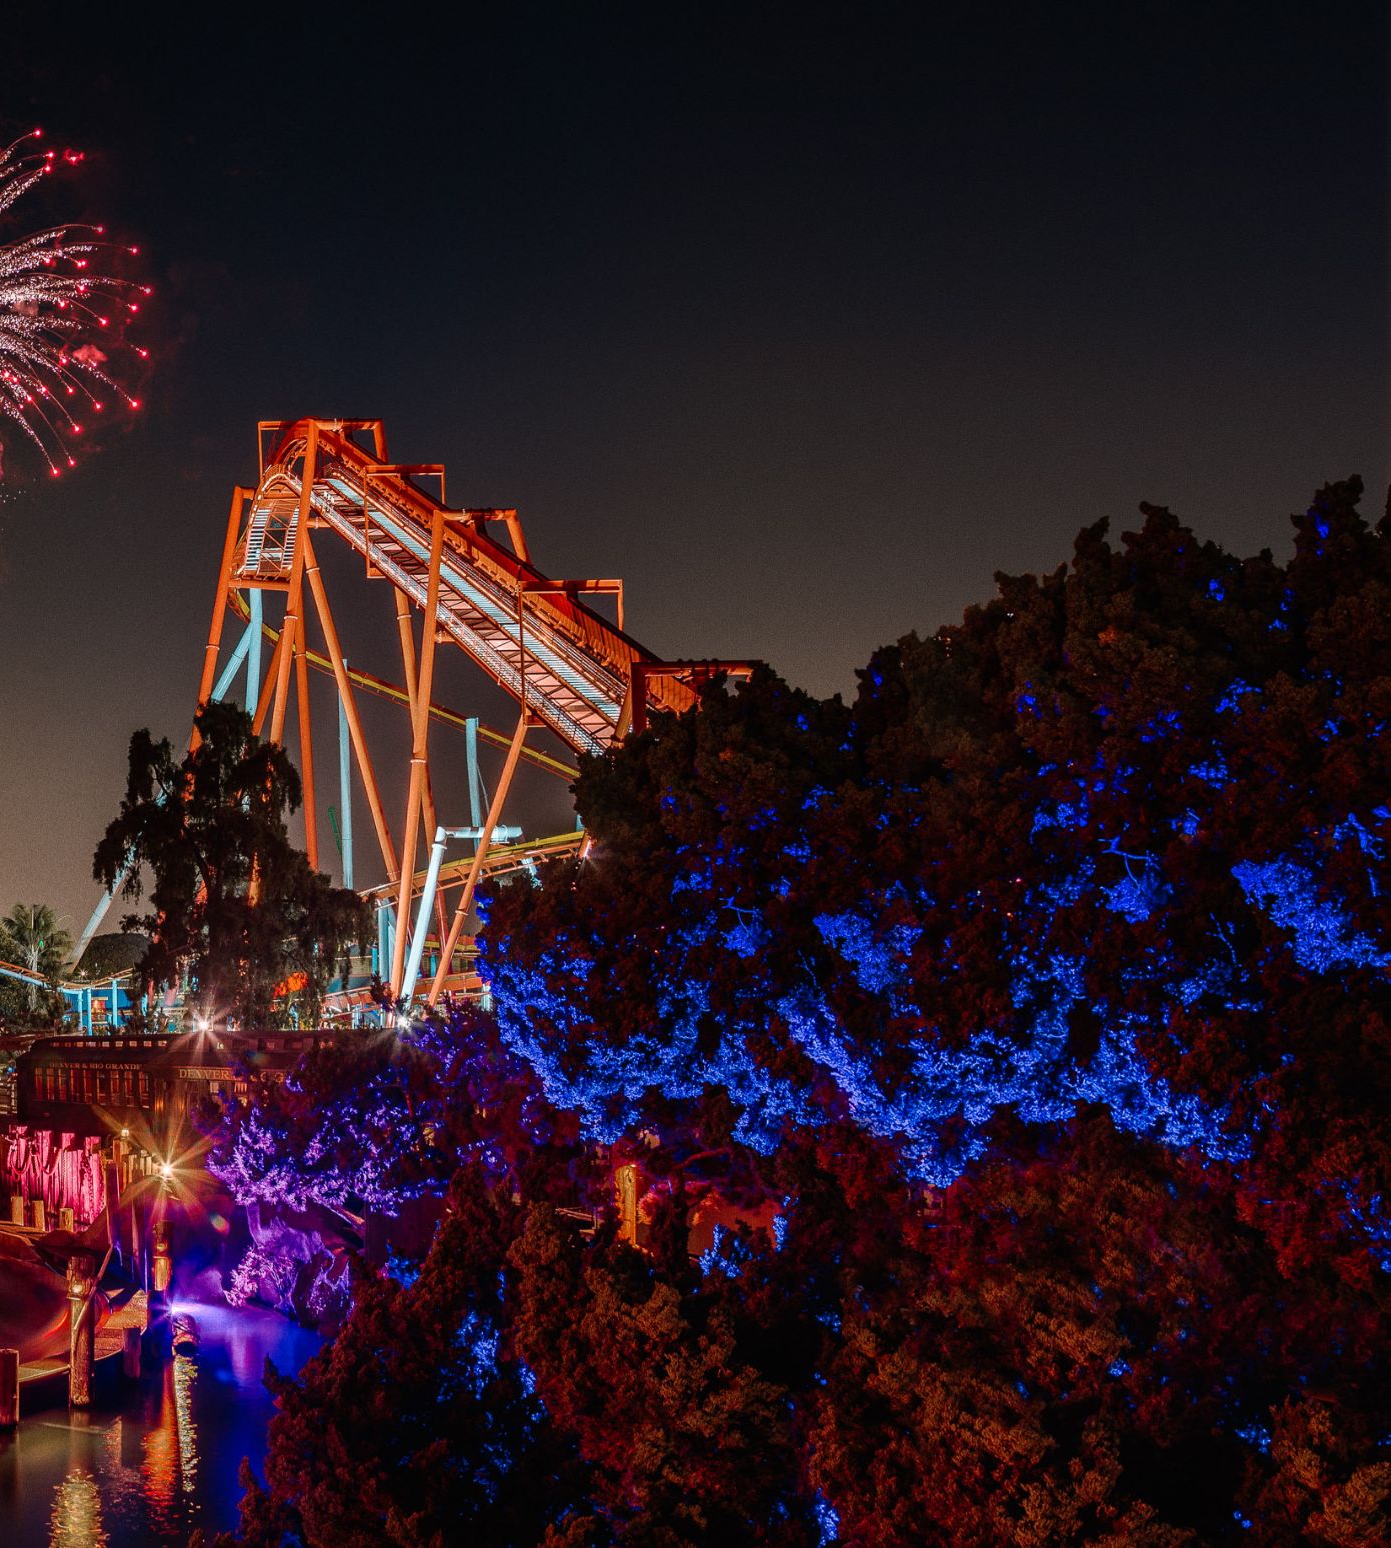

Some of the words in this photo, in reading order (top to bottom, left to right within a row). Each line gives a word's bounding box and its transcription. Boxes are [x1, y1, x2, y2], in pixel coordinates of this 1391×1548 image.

[49, 1062, 80, 1070] DENVER
[105, 1063, 142, 1071] GRANDE
[178, 1068, 230, 1080] DENVER
